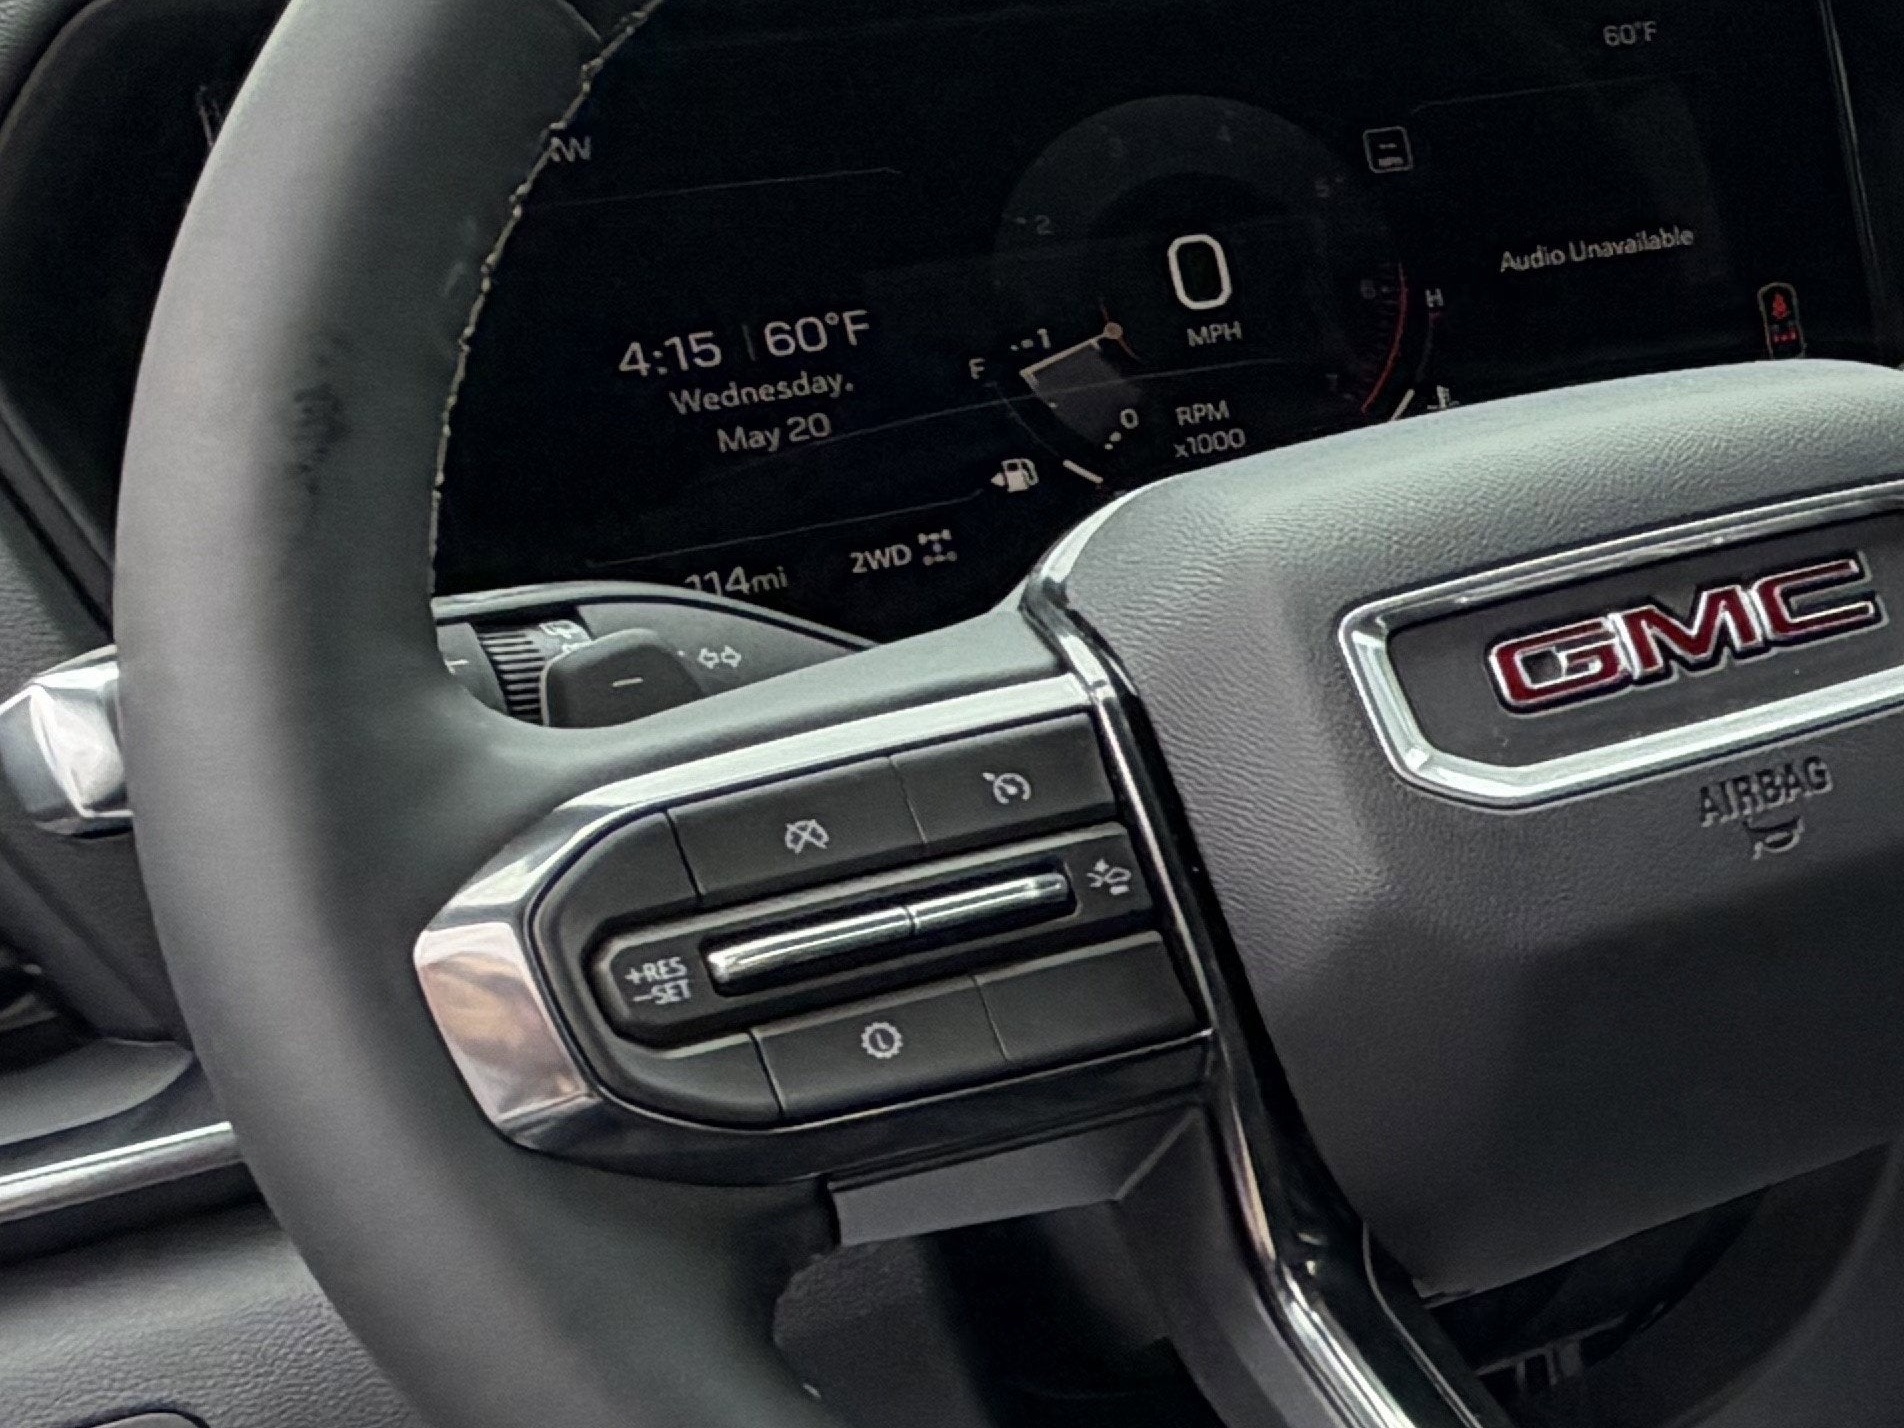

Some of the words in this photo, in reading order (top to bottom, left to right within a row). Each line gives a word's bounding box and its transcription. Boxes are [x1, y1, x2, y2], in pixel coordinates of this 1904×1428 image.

[1603, 20, 1657, 47] 60°F
[1500, 244, 1566, 273] Audio
[1568, 224, 1695, 264] Unavailable
[1167, 233, 1233, 310] 0
[1425, 287, 1444, 309] H
[618, 330, 722, 377] 4:15
[763, 308, 870, 357] 60°F
[1186, 320, 1243, 347] MPH
[967, 356, 987, 380] F
[1119, 407, 1140, 430] 0
[1175, 399, 1230, 427] RPM
[716, 424, 782, 454] May
[786, 412, 833, 443] 20
[1173, 427, 1247, 459] x1000
[849, 543, 913, 574] 2WD
[1488, 556, 1884, 714] GMC
[1699, 756, 1834, 828] AIRBAG
